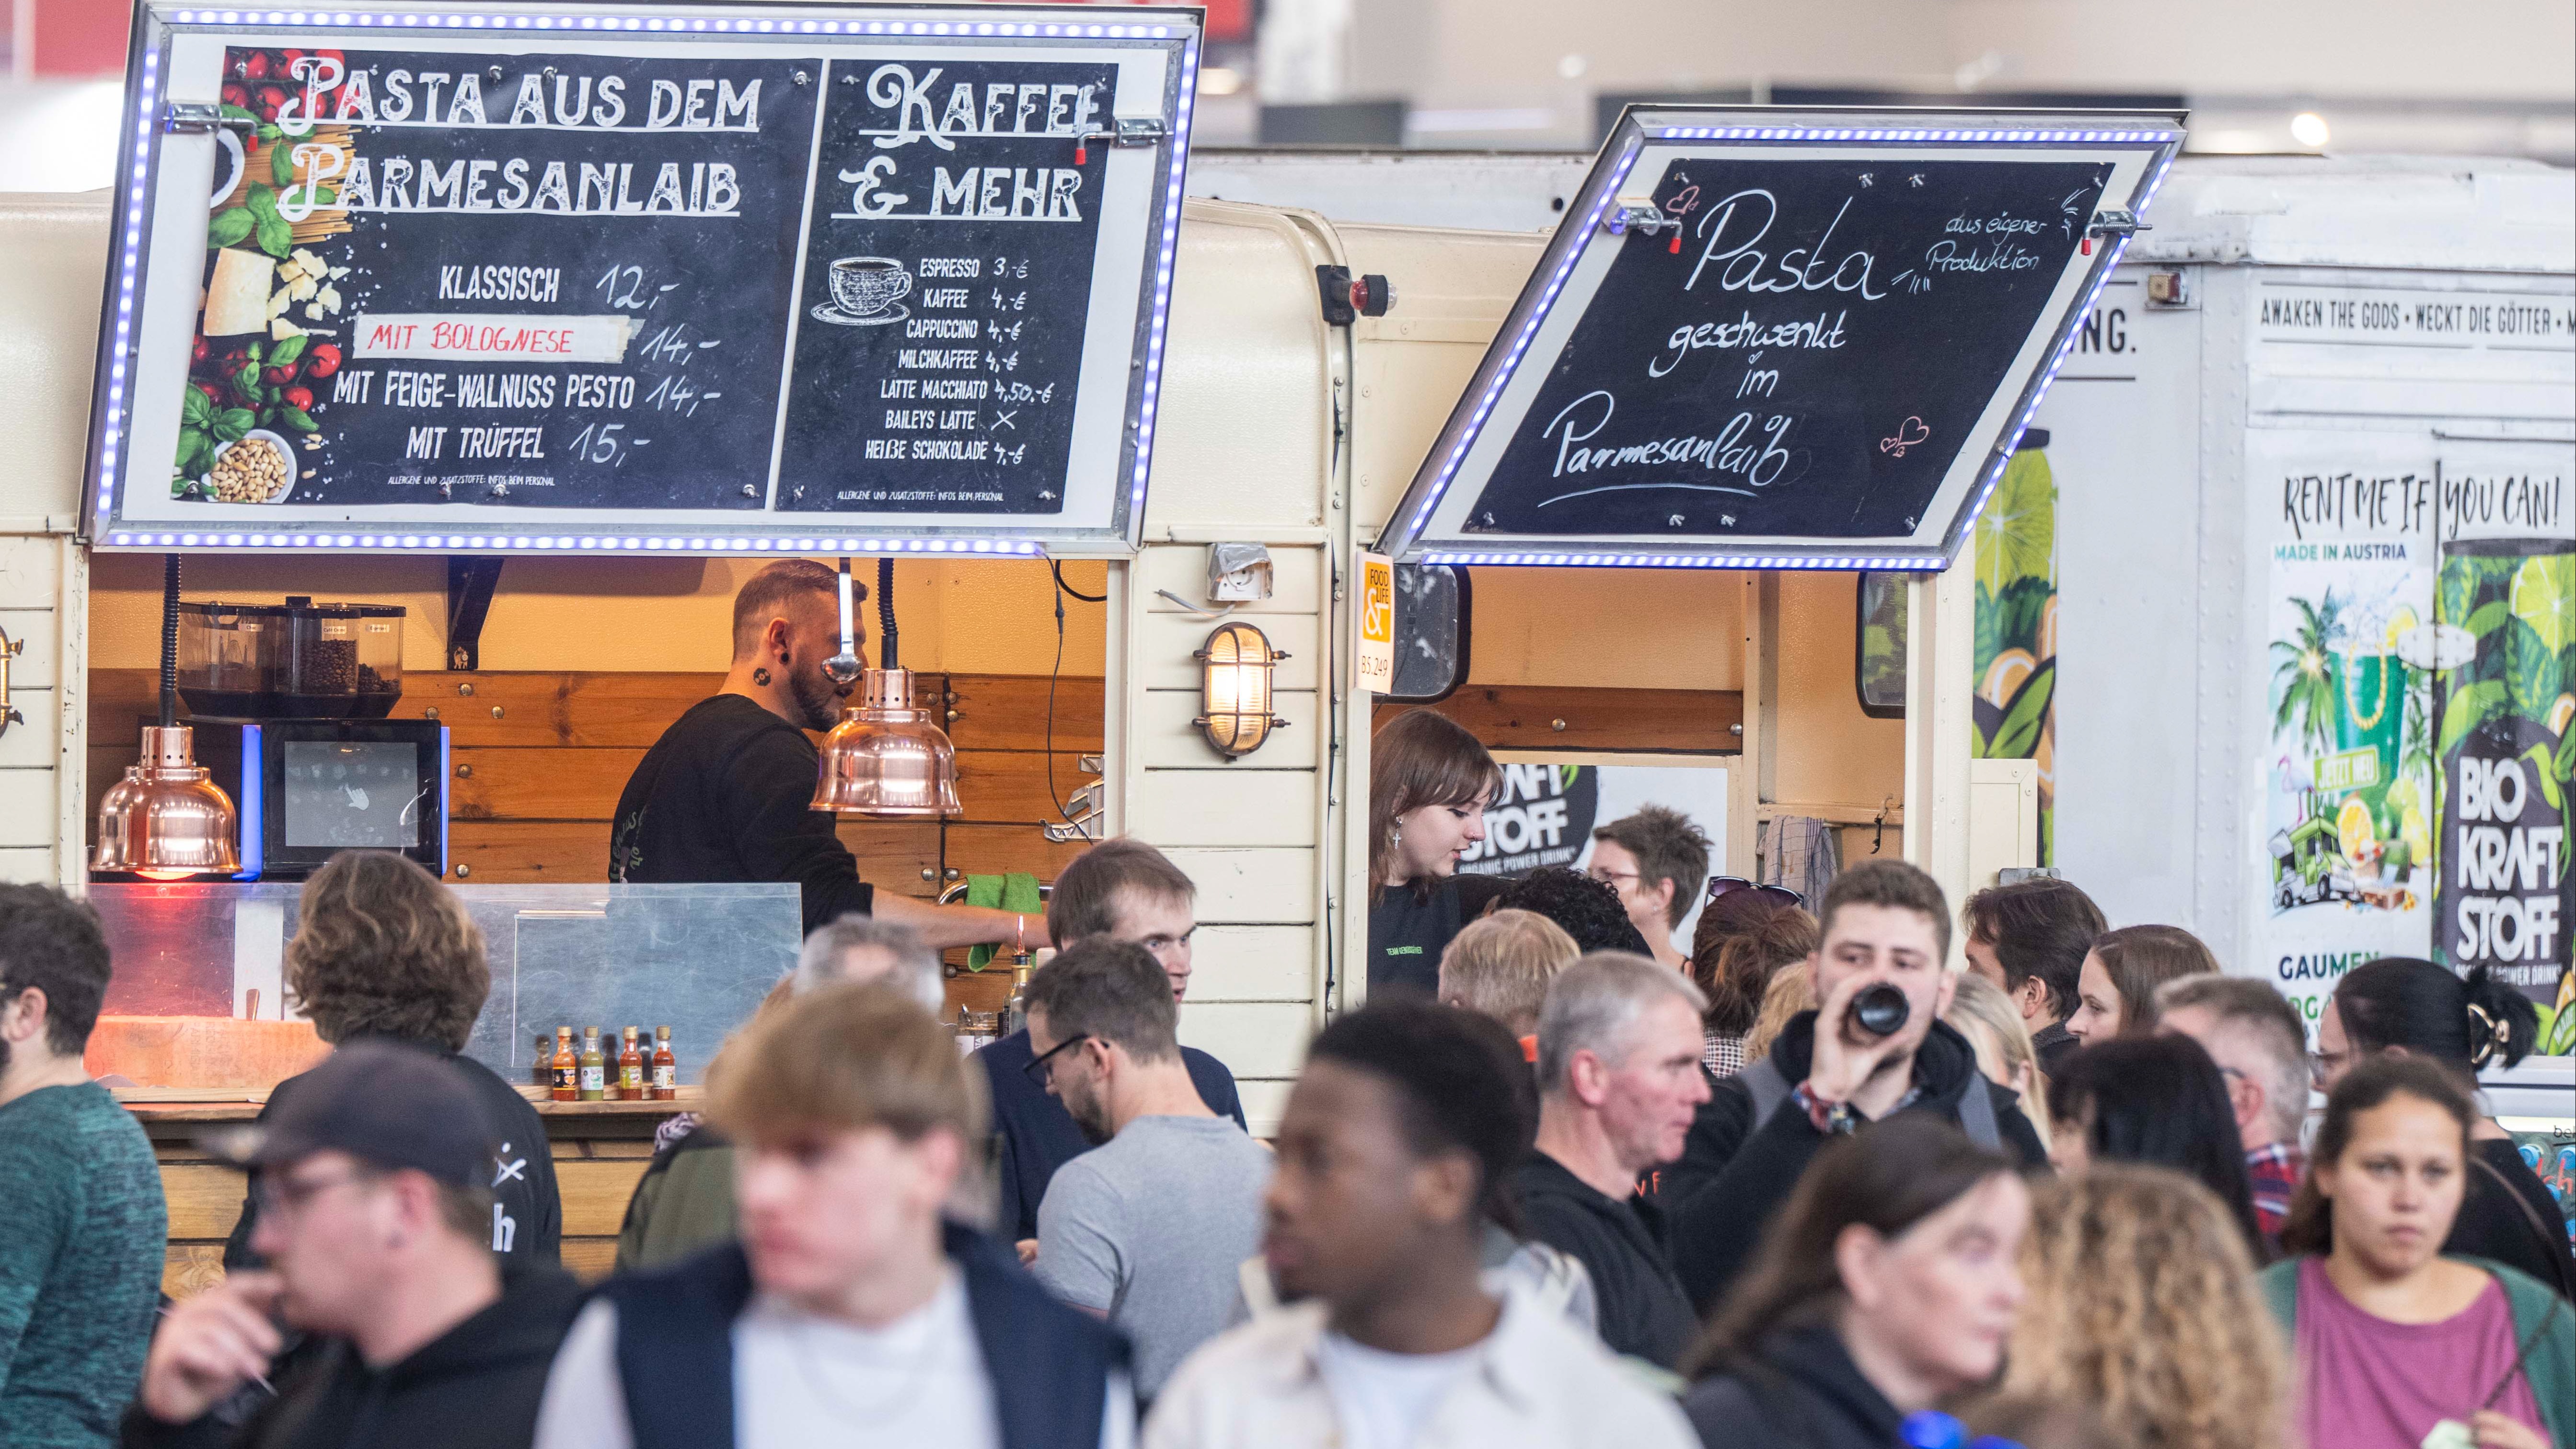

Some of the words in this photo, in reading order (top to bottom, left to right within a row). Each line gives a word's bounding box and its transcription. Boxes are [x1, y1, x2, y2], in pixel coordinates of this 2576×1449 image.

[278, 57, 487, 136] PASTA
[509, 73, 627, 127] AUS
[647, 78, 763, 129] DEM
[867, 64, 1102, 151] KAFFEE
[278, 143, 741, 222] PARMESANLAIB
[838, 156, 909, 220] &
[929, 167, 1082, 218] MEHR
[1682, 187, 1887, 300] Pasta
[1945, 216, 1981, 234] aus
[1986, 210, 2047, 246] eigener
[919, 258, 981, 278] ESPRESSO
[1926, 240, 2040, 272] Produktion
[439, 265, 561, 302] KLASSISCH
[595, 264, 680, 311] 12,-
[923, 289, 969, 308] KAFFEE
[906, 319, 979, 338] CAPPUCCINO
[2070, 309, 2136, 354] NG.
[2261, 298, 2322, 327] AWAKEN
[2329, 301, 2356, 329] THE
[2362, 302, 2400, 331] GODS
[2415, 304, 2463, 333] WECKT
[2469, 305, 2491, 334] DIE
[2497, 301, 2552, 335] GÖTTER
[367, 324, 418, 351] MIT
[430, 321, 574, 354] BOLOGNESE
[1649, 310, 1847, 378] geschwenkt
[898, 349, 979, 370] MILCHKAFFEE
[1736, 349, 1779, 399] im
[333, 370, 375, 405] MIT
[384, 372, 556, 409] FEIGE-WALNUSS
[565, 376, 635, 410] PESTO
[880, 380, 916, 399] LATTE
[921, 380, 988, 399] MACCHIATO
[885, 410, 935, 429] BAILEYS
[939, 410, 977, 430] LATTE
[1542, 390, 1790, 487] Parmesanlaib
[405, 426, 448, 460] MIT
[459, 422, 545, 459] TRÜFFEL
[912, 440, 989, 460] SCHOKOLADE
[387, 476, 422, 485] ALLERGENE
[424, 476, 437, 485] UND
[488, 476, 506, 485] INFOS
[508, 476, 523, 485] BEIM
[525, 477, 555, 486] PERSONAL
[837, 491, 871, 500] ALLERGENE
[873, 492, 887, 500] UND
[888, 491, 936, 500] ZUSATZSTOFFE:
[938, 492, 956, 501] INFOS
[958, 492, 973, 501] BEIM
[974, 492, 1004, 501] PERSONAL
[2284, 473, 2352, 540] RENT
[2354, 478, 2395, 532] ME
[2399, 474, 2431, 533] IF
[2502, 475, 2560, 530] CAN!
[2274, 544, 2318, 561] MADE
[2323, 544, 2337, 561] IN
[2343, 543, 2407, 561] AUSTRIA
[1370, 569, 1389, 587] FOOD
[1376, 588, 1389, 604] LIFE
[1361, 656, 1388, 676] B5.249
[2458, 756, 2527, 823] BIO
[2457, 825, 2563, 892] KRAFT
[2456, 894, 2561, 962] STOFF
